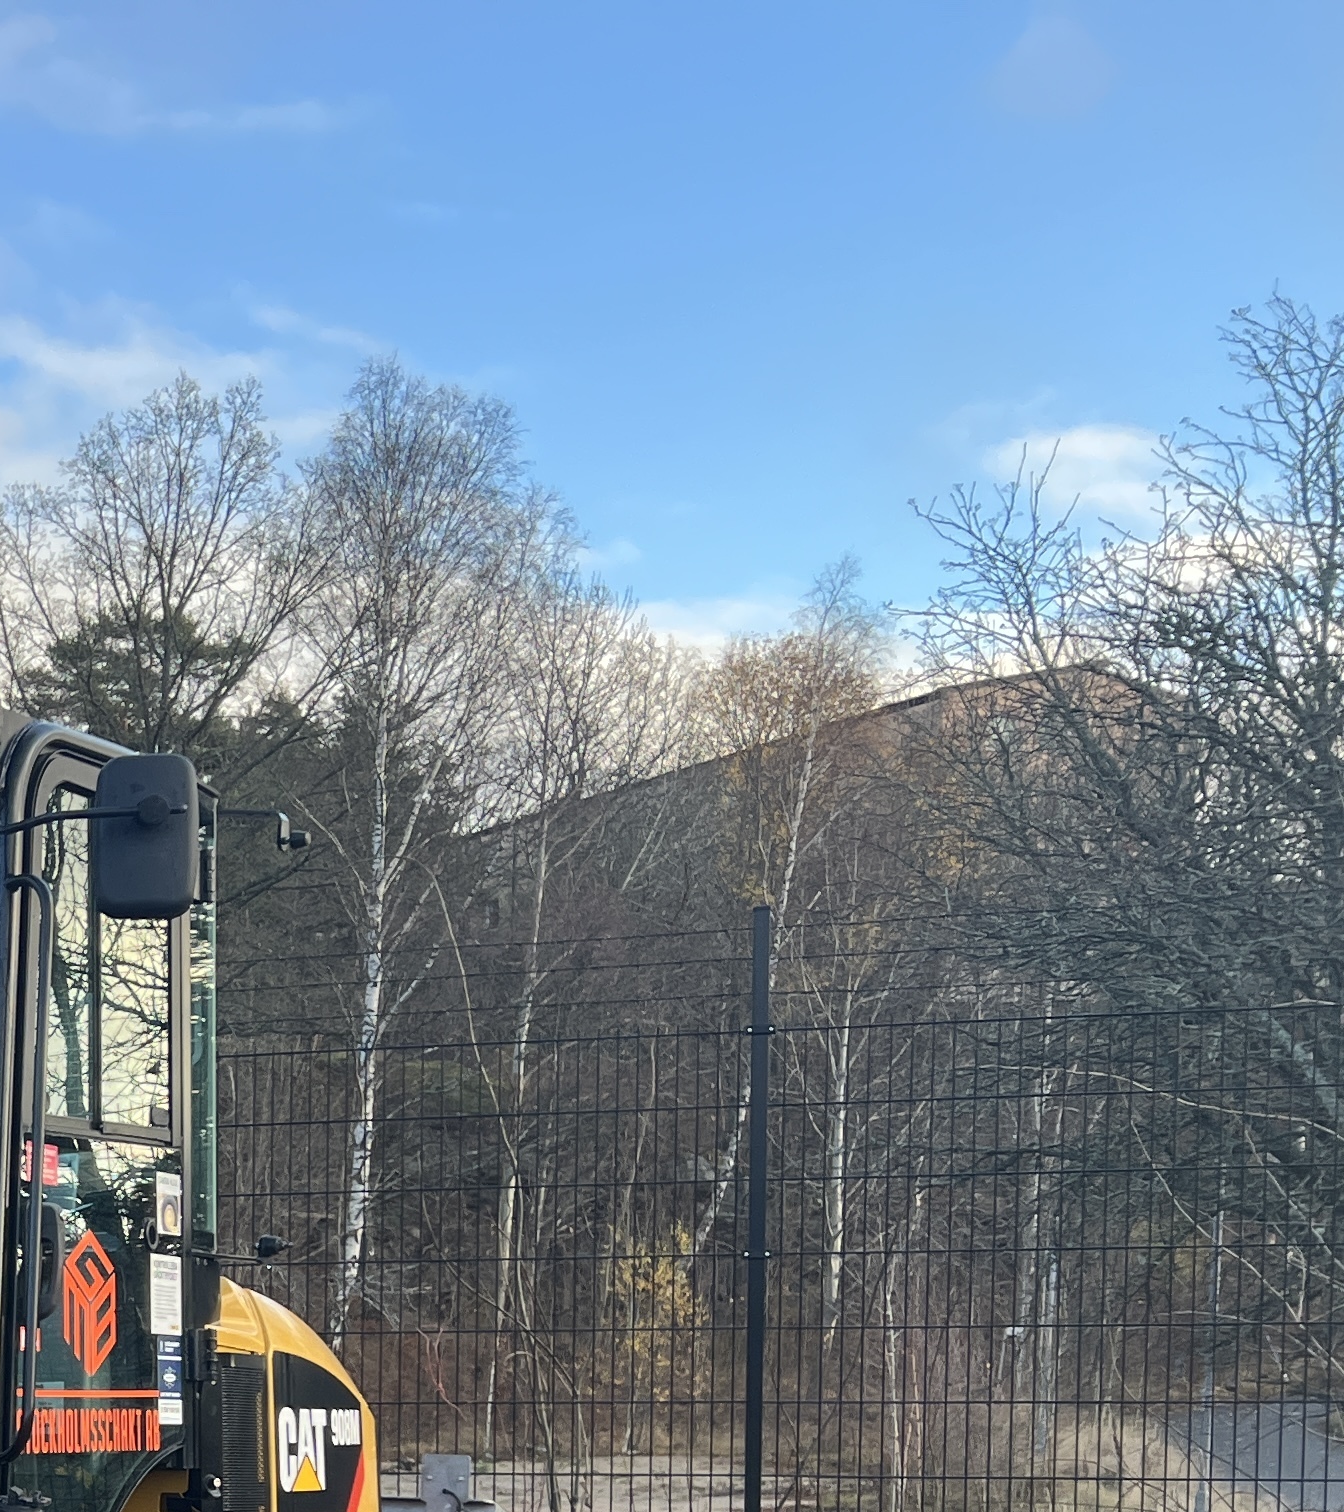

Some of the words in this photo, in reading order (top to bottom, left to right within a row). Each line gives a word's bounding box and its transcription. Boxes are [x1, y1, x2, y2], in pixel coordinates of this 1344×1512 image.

[16, 1408, 142, 1454] OCKHOLMSSCHAKT
[145, 1409, 160, 1451] AB
[278, 1406, 328, 1493] CAT
